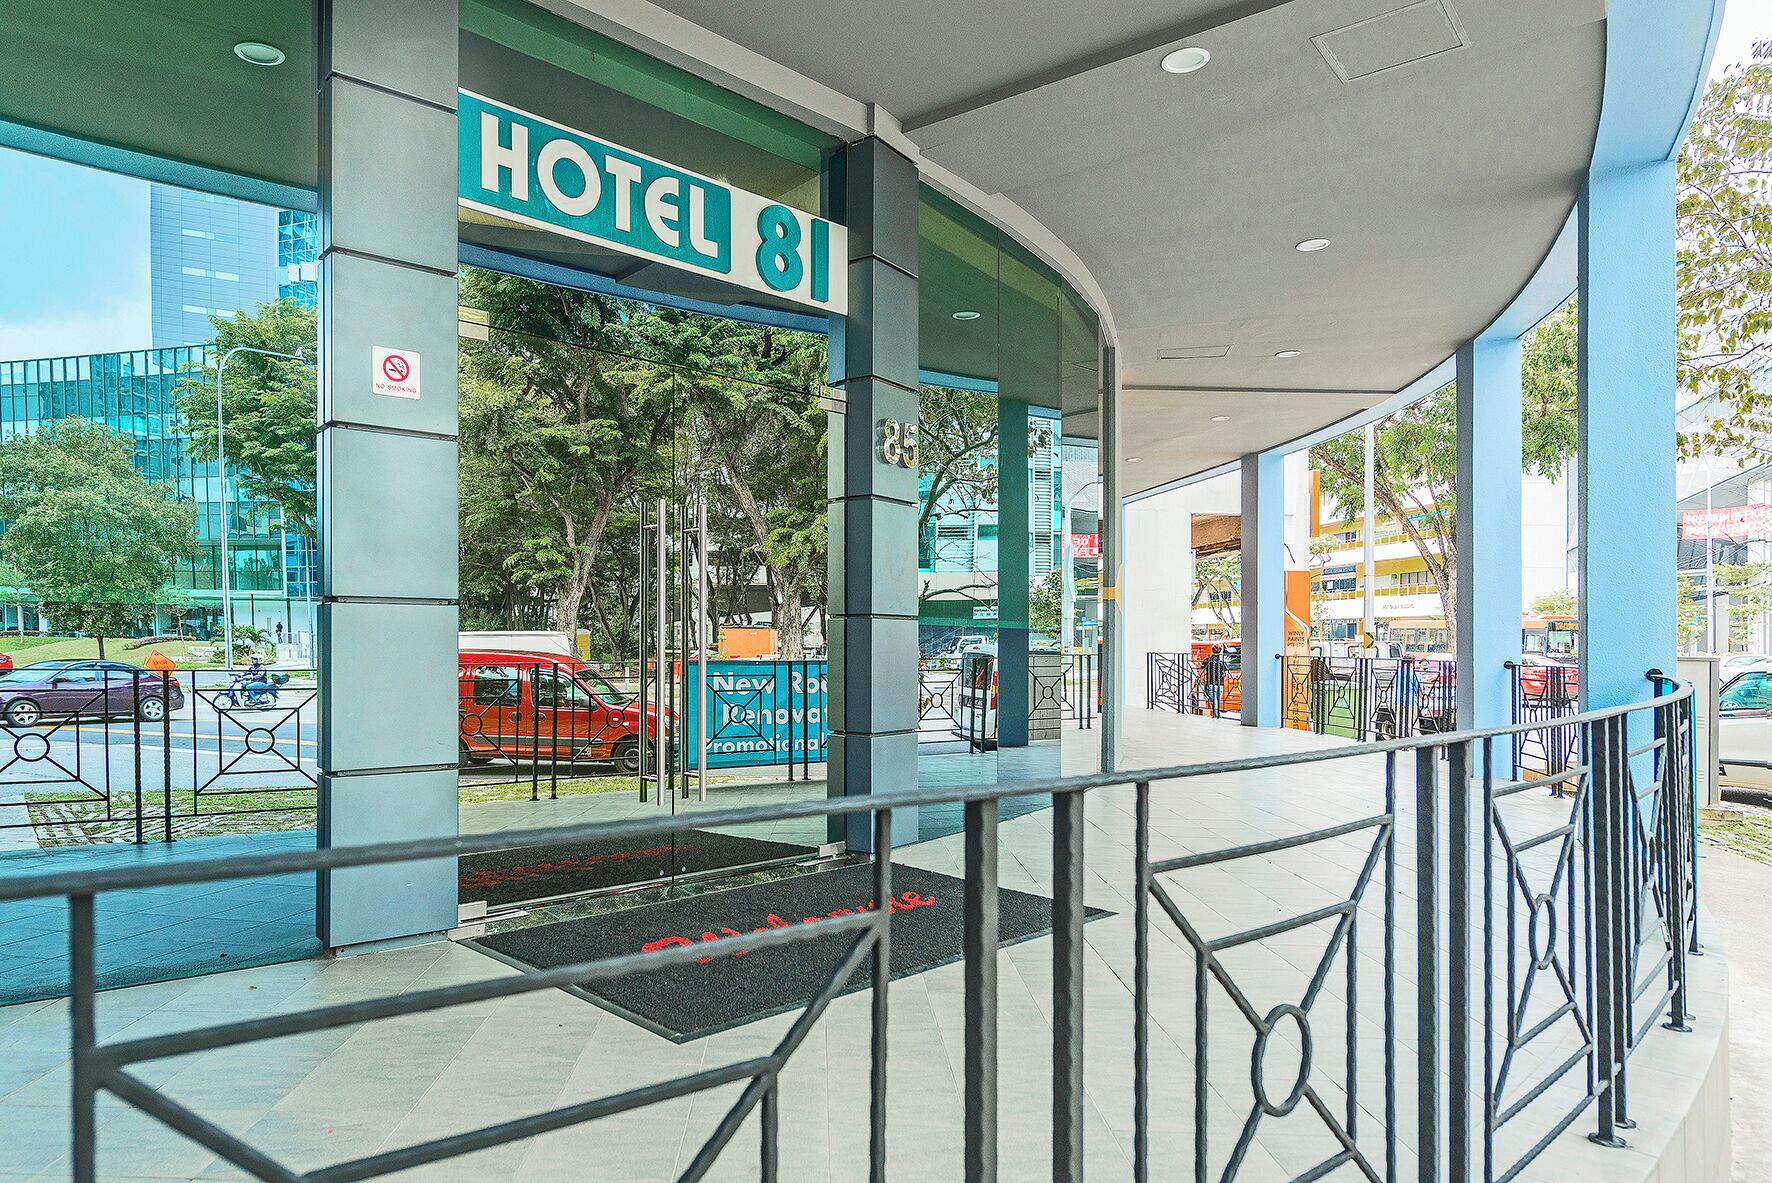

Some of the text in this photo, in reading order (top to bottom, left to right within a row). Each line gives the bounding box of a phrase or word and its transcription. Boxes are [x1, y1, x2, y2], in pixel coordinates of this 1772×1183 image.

[480, 111, 830, 303] HOTEL 81
[387, 385, 417, 394] SMOKING
[880, 418, 919, 468] 85
[712, 671, 777, 695] New
